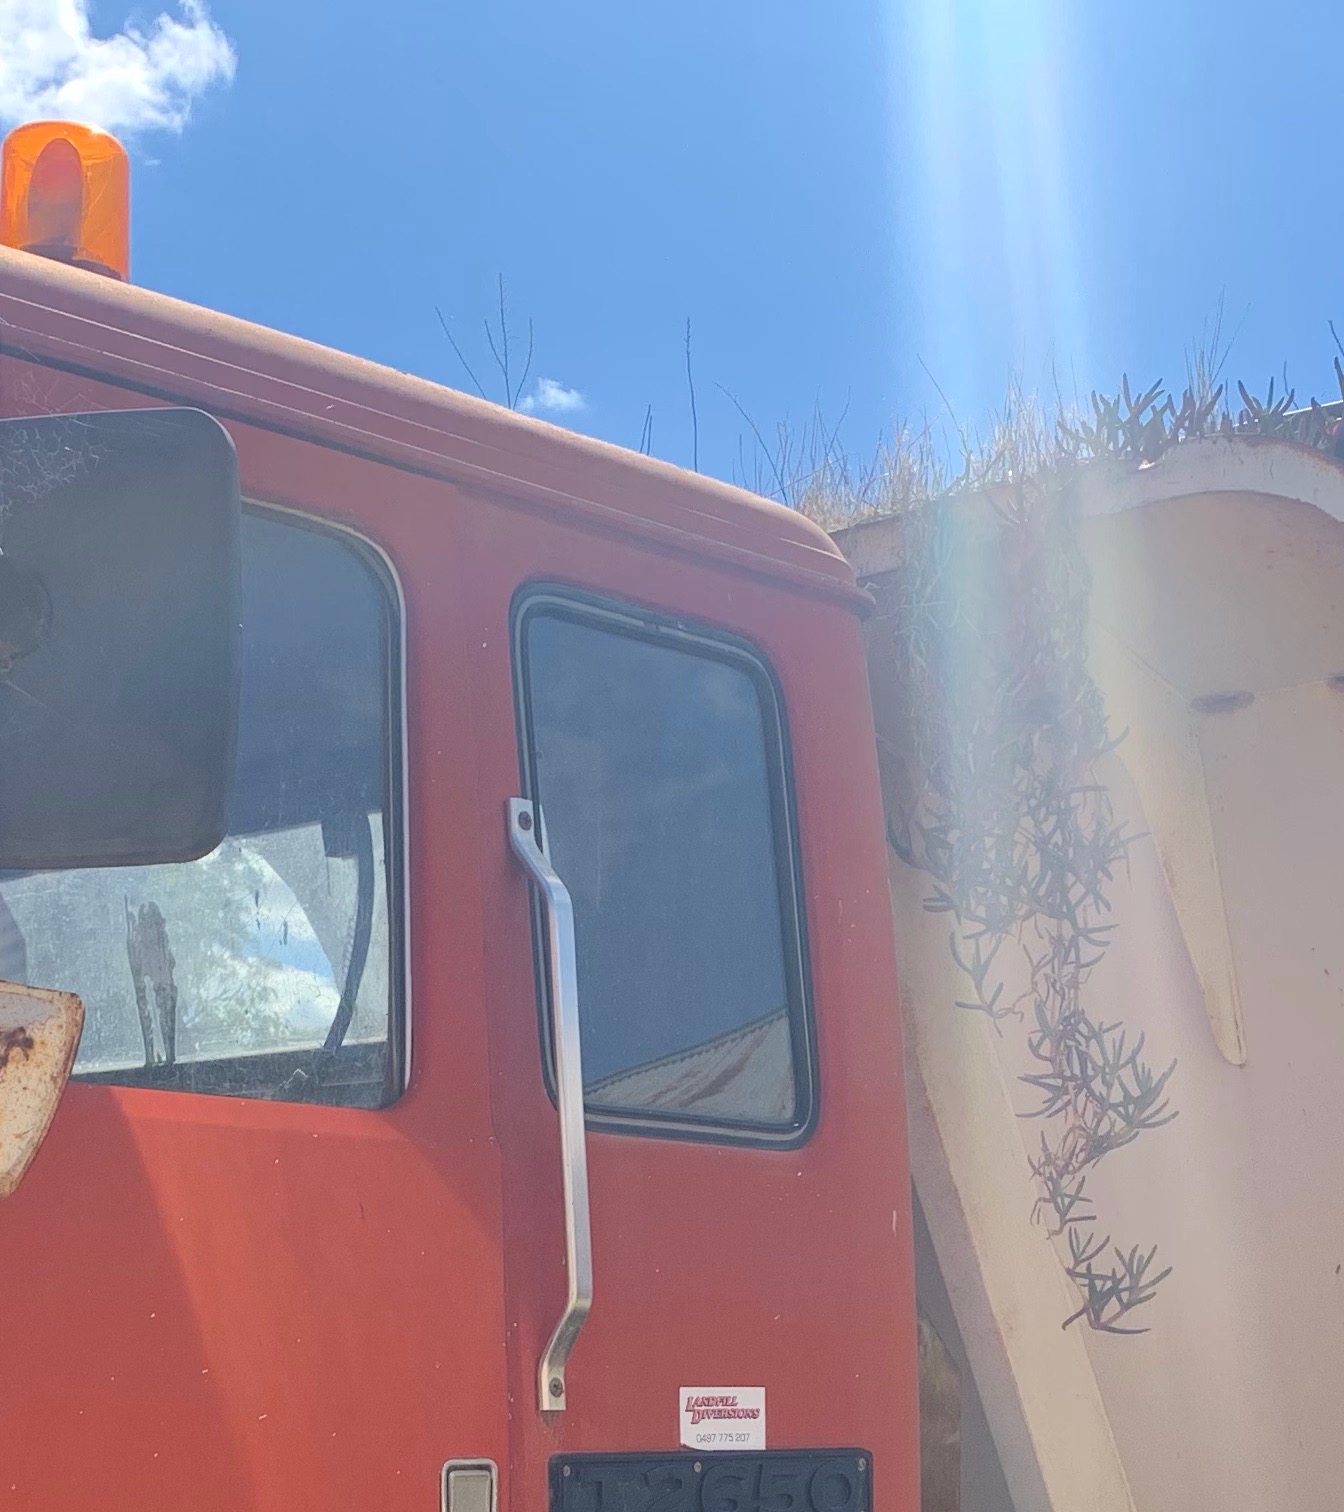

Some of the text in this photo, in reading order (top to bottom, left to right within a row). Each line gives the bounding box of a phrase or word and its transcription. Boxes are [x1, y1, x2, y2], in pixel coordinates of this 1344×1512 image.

[685, 1395, 738, 1411] LANDFILL
[691, 1408, 761, 1424] DIVERSIONS
[719, 1433, 734, 1442] 775
[735, 1433, 750, 1442] 207
